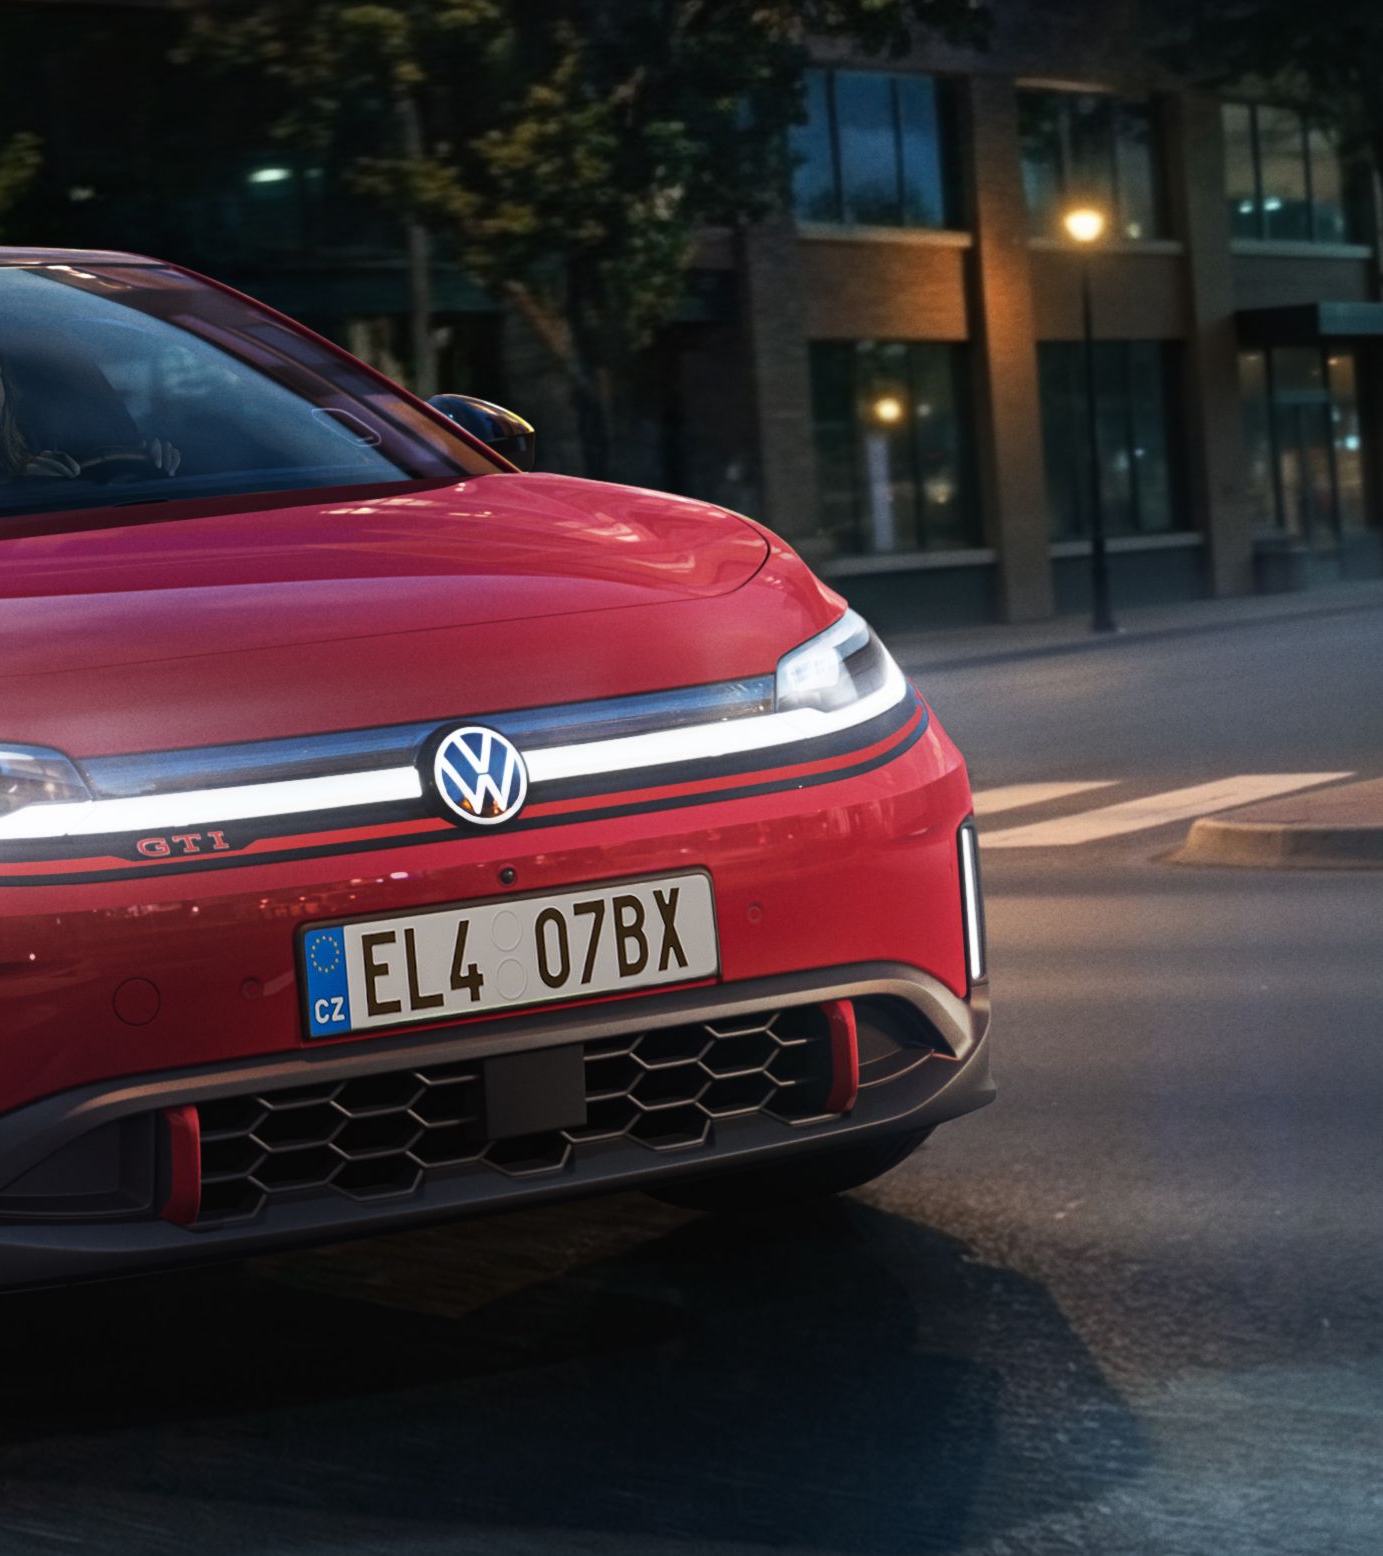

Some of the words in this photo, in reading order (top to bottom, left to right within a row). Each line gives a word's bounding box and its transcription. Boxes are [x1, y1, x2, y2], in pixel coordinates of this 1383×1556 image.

[434, 726, 527, 825] VW
[136, 830, 230, 857] GTI
[361, 920, 484, 1018] EL4
[534, 887, 688, 990] 07BX
[314, 996, 345, 1025] CZ
